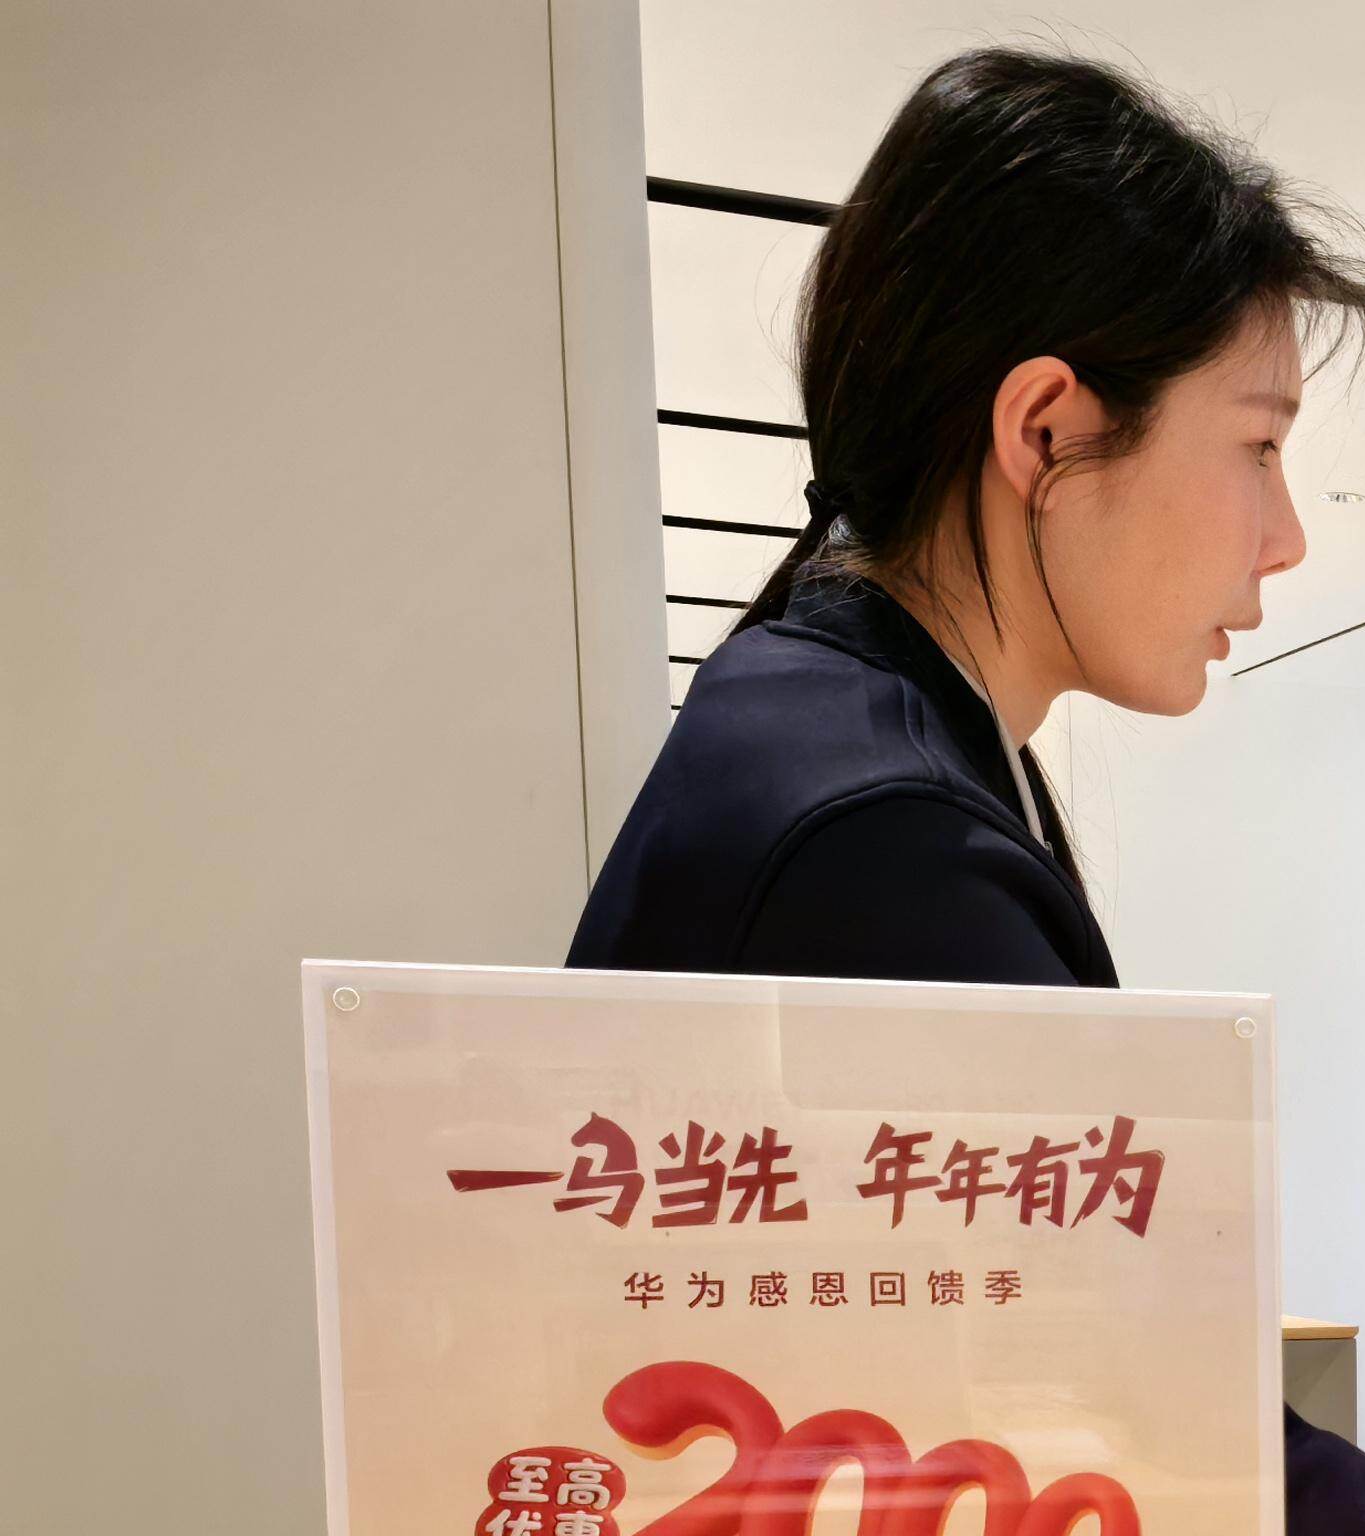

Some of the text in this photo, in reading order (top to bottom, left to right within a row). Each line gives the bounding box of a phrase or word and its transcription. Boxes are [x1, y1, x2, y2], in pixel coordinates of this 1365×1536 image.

[445, 1110, 1166, 1240] 一马当先 年年有为
[624, 1269, 1025, 1310] 华为感恩回馈季
[496, 1453, 614, 1511] 至高
